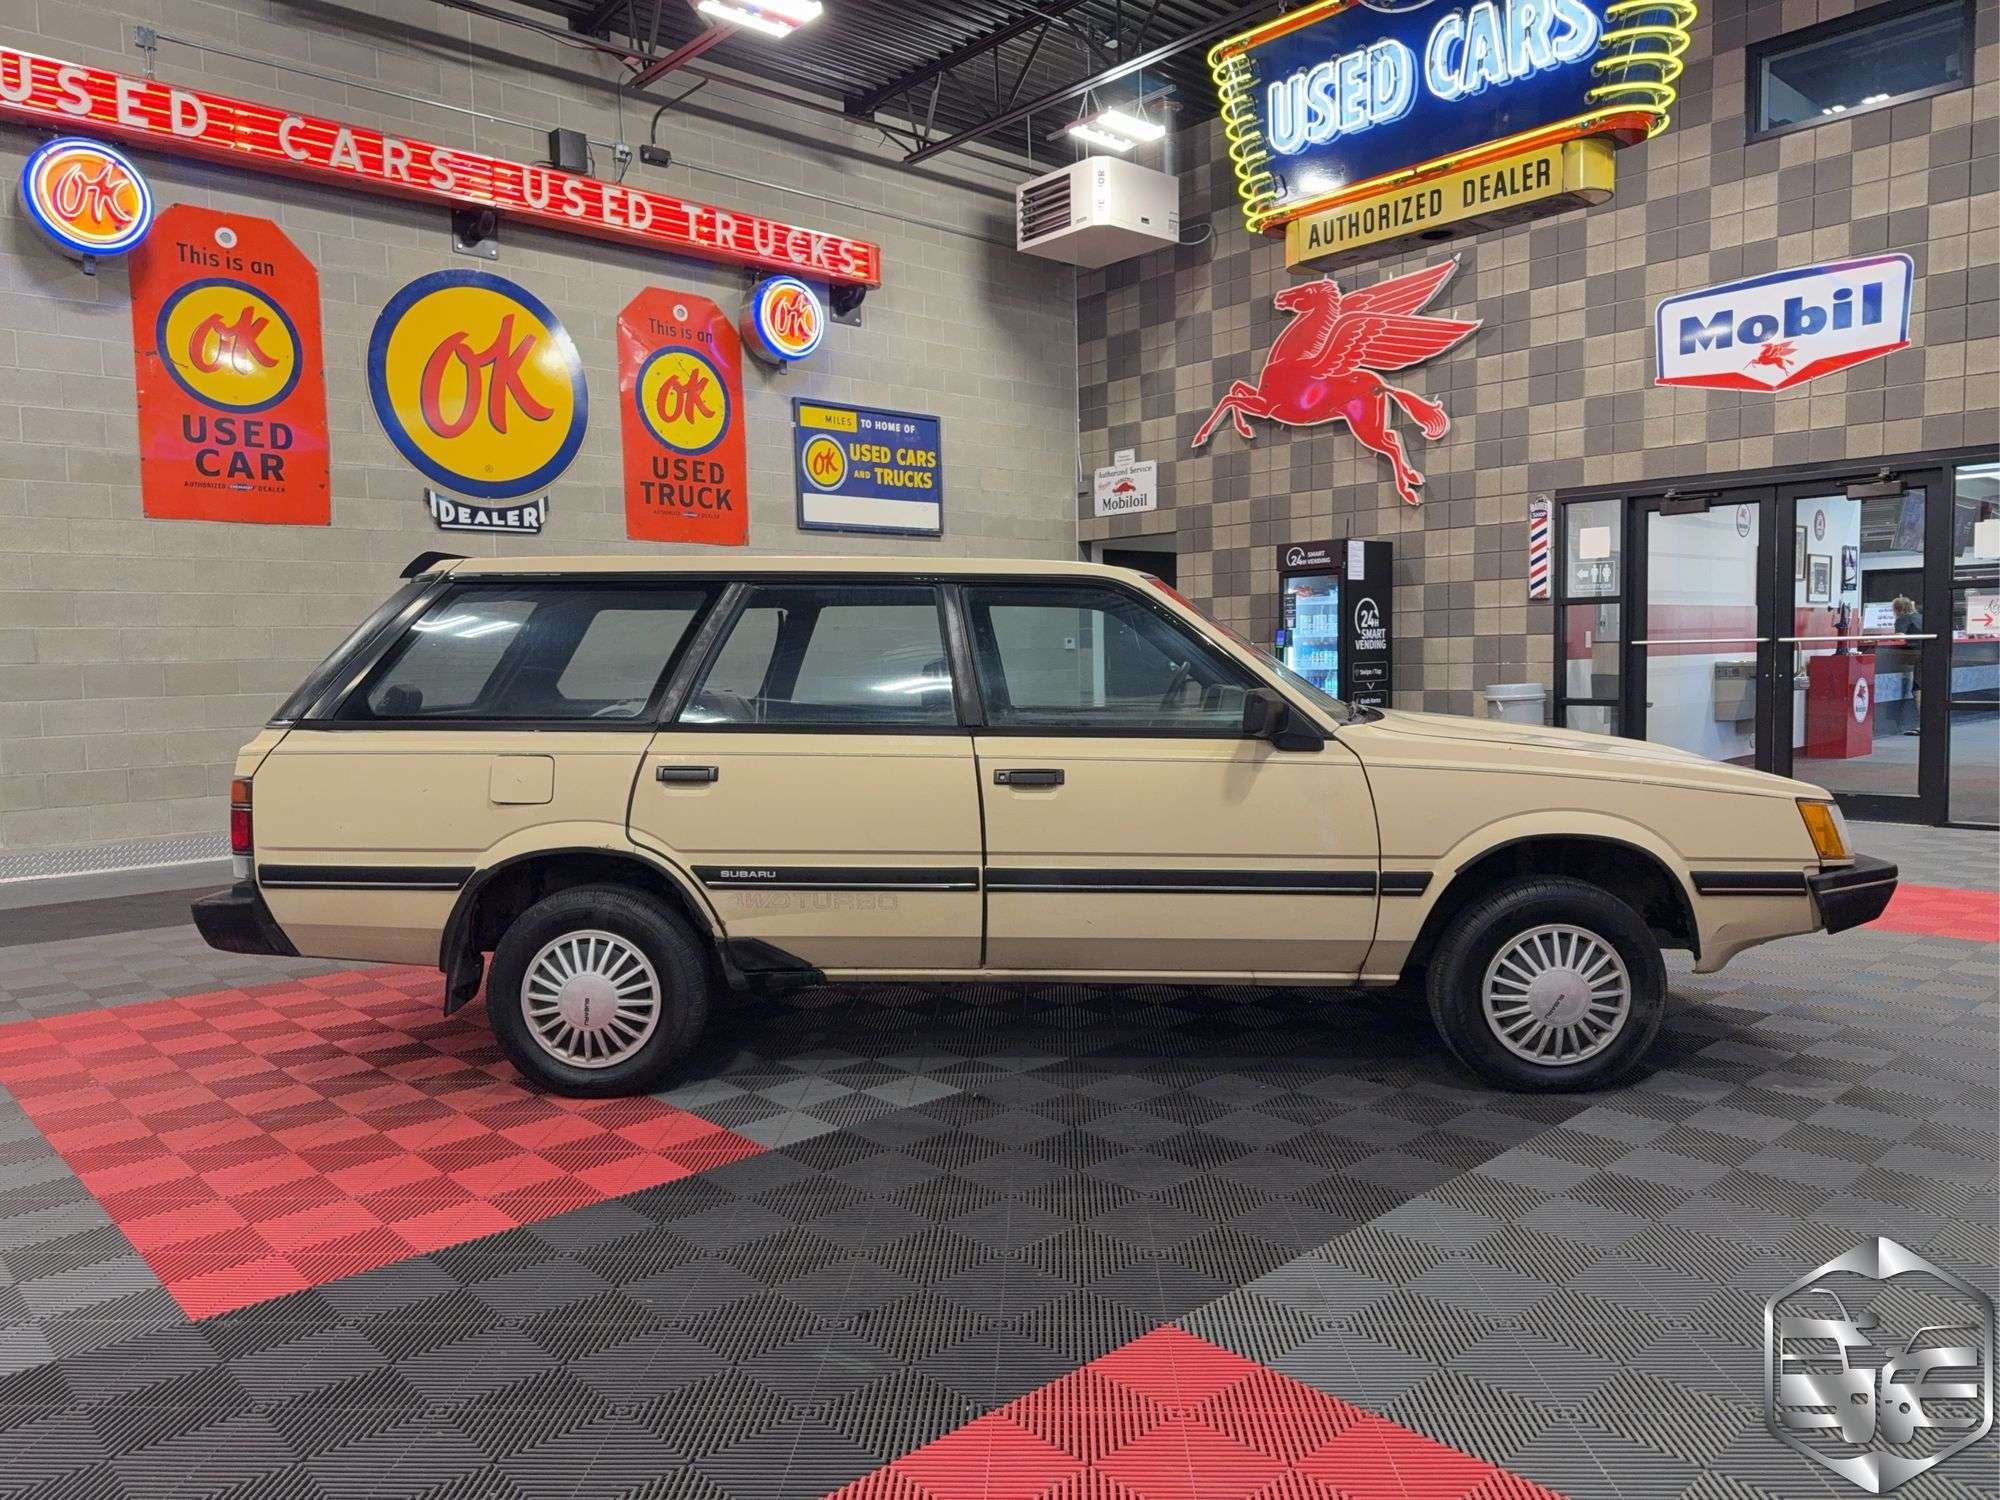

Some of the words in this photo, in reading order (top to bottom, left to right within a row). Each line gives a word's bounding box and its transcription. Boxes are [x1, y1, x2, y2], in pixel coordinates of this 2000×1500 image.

[1267, 37, 1419, 155] USED
[1424, 0, 1604, 100] CARS
[0, 57, 208, 138] USED
[278, 115, 456, 191] CARS
[522, 167, 653, 231] USED
[681, 203, 857, 274] TRUCKS
[55, 161, 134, 223] OK
[1308, 189, 1443, 250] AUTHORIZED
[1463, 158, 1551, 208] DEALER
[176, 241, 220, 267] This
[226, 254, 243, 271] is
[251, 259, 275, 277] an
[648, 318, 676, 338] This
[680, 327, 693, 340] is
[697, 329, 713, 344] an
[774, 297, 815, 337] OK
[1679, 281, 1883, 356] Mobil
[188, 306, 280, 375] OK
[420, 313, 553, 440] OK
[656, 368, 716, 425] OK
[182, 414, 293, 450] USED
[824, 414, 853, 427] MILES
[860, 418, 872, 430] TO
[875, 419, 901, 432] HOME
[904, 423, 916, 434] OF
[195, 449, 286, 481] CAR
[652, 455, 724, 485] USED
[812, 450, 838, 475] OK
[849, 443, 891, 464] USED
[896, 448, 937, 468] CARS
[853, 469, 871, 479] AND
[875, 467, 933, 489] TRUCKS
[640, 481, 732, 511] TRUCK
[1102, 493, 1147, 511] Mobiloil
[439, 504, 538, 529] DEALER
[1355, 639, 1387, 650] VENDING
[1361, 628, 1386, 640] SMART
[720, 869, 776, 879] SUBARU
